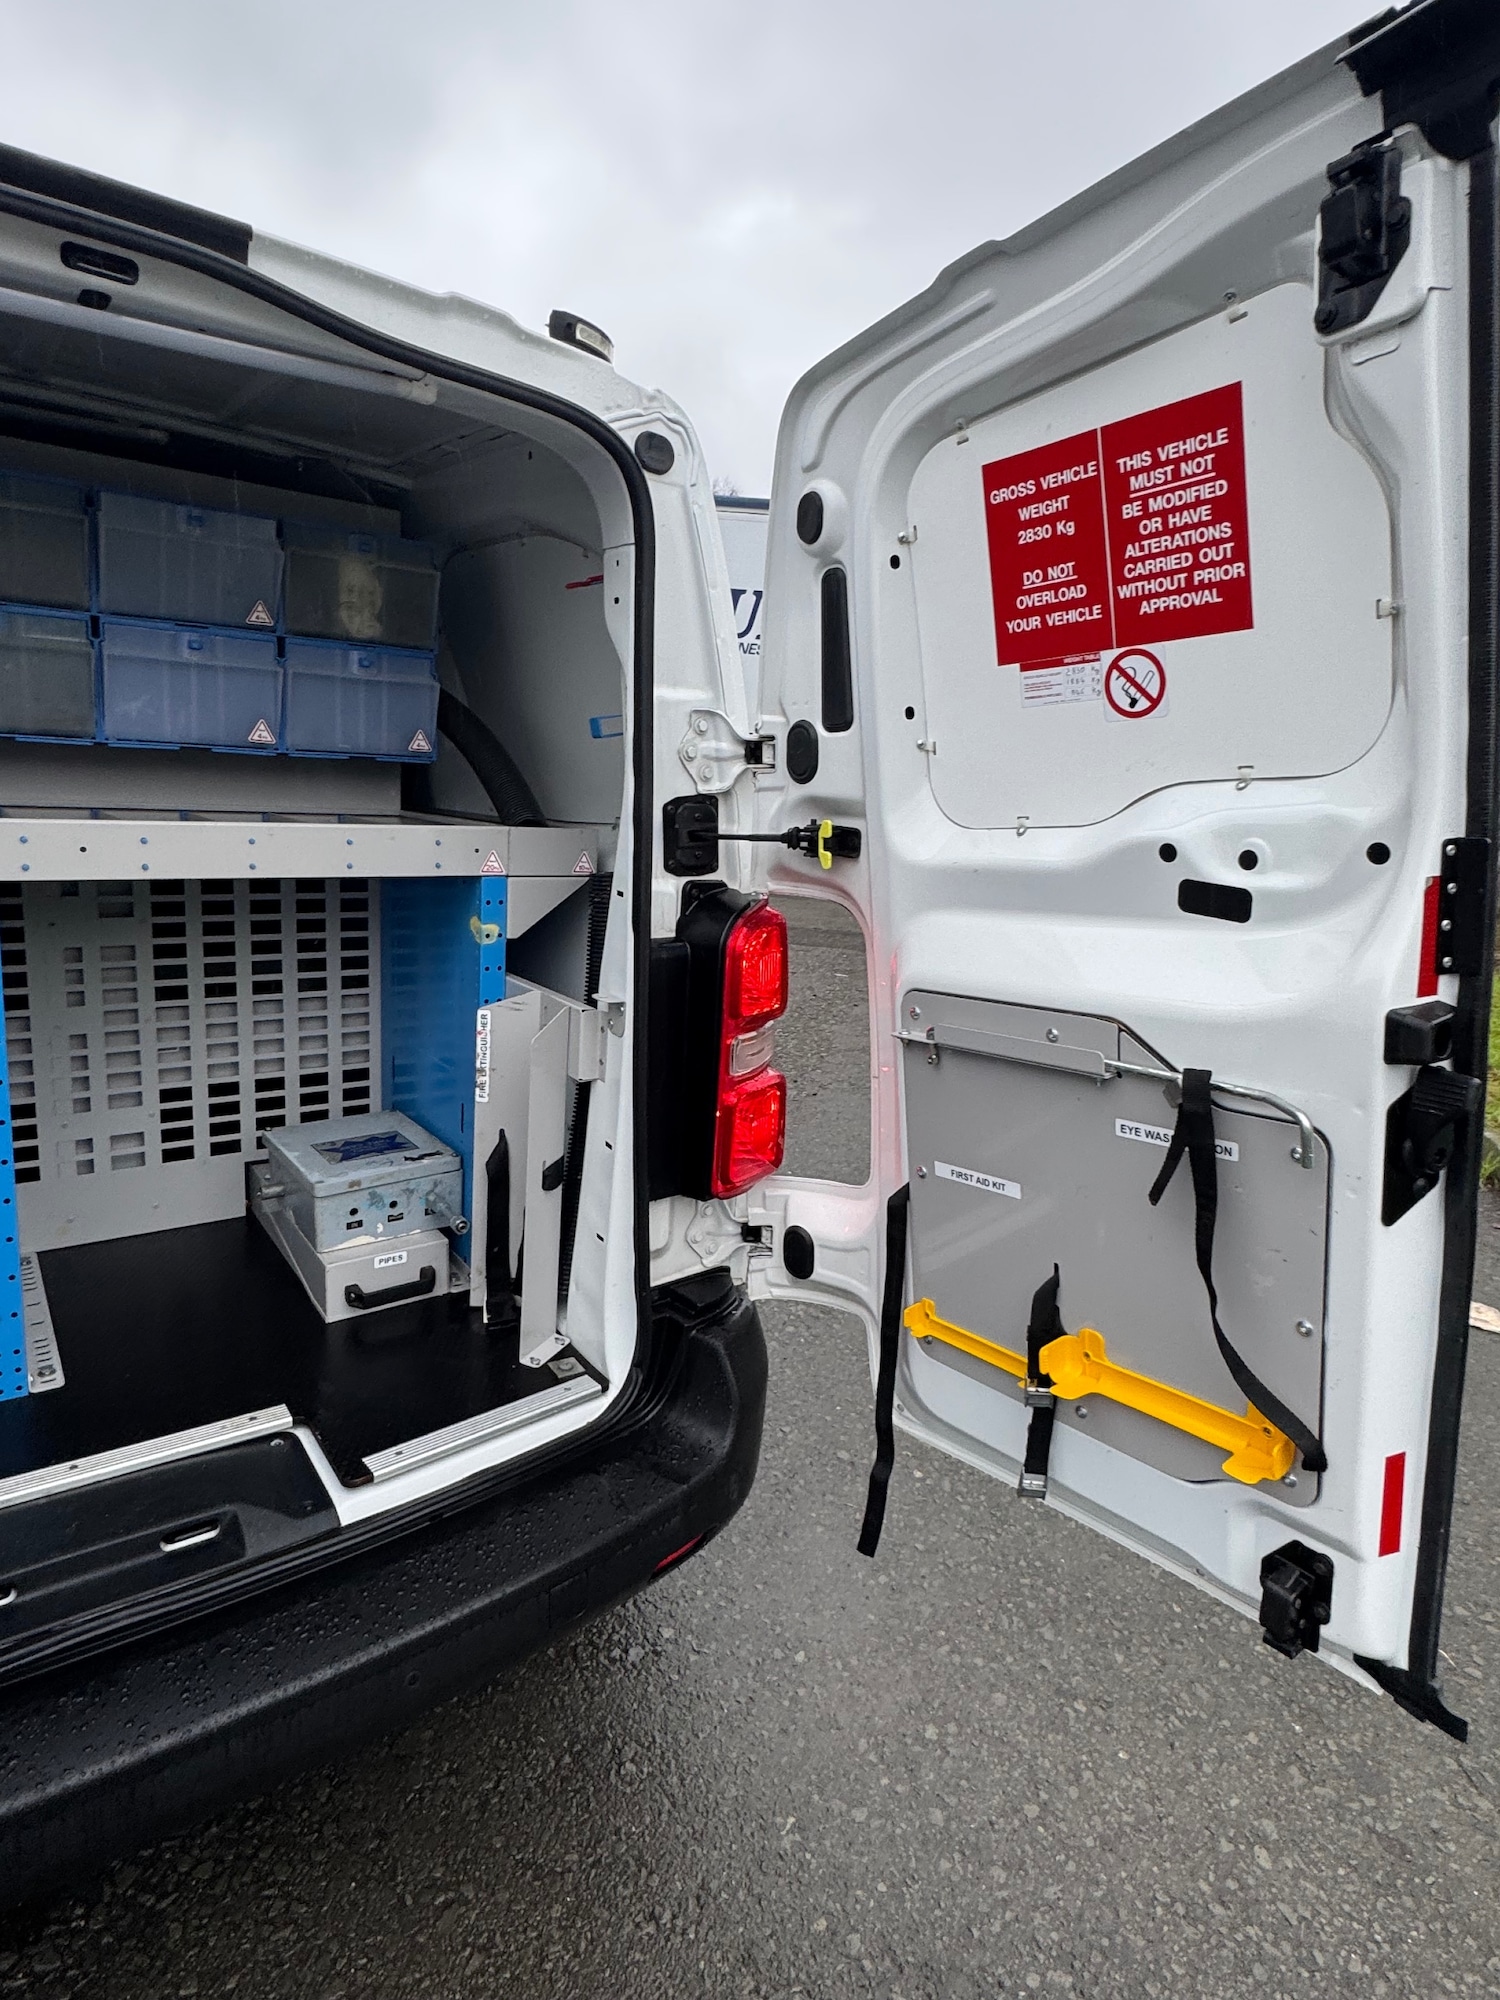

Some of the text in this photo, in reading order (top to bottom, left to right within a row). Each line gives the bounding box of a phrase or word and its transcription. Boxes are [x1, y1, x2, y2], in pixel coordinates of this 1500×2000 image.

[1116, 428, 1229, 474] THIS VEHICLE
[990, 461, 1098, 504] GROSS VEHICLE
[1130, 454, 1215, 491] MUST NOT
[1018, 495, 1070, 521] WEIGHT
[1122, 479, 1228, 519] BE MODIFIED
[1018, 520, 1075, 544] 2830 Kg
[1139, 505, 1212, 535] OR HAVE
[1124, 522, 1232, 559] ALTERATIONS
[1023, 562, 1075, 586] DO NOT
[1124, 542, 1235, 579] CARRIED OUT
[1117, 562, 1246, 599] WITHOUT PRIOR
[1016, 584, 1087, 610] OVERLOAD
[1139, 588, 1223, 616] APPROVAL
[1006, 604, 1102, 634] YOUR VEHICLE
[1120, 1124, 1142, 1137] EYE
[1144, 1129, 1170, 1143] WAS
[950, 1169, 1006, 1192] FIRST AID KIT
[378, 1254, 402, 1266] PIPES
